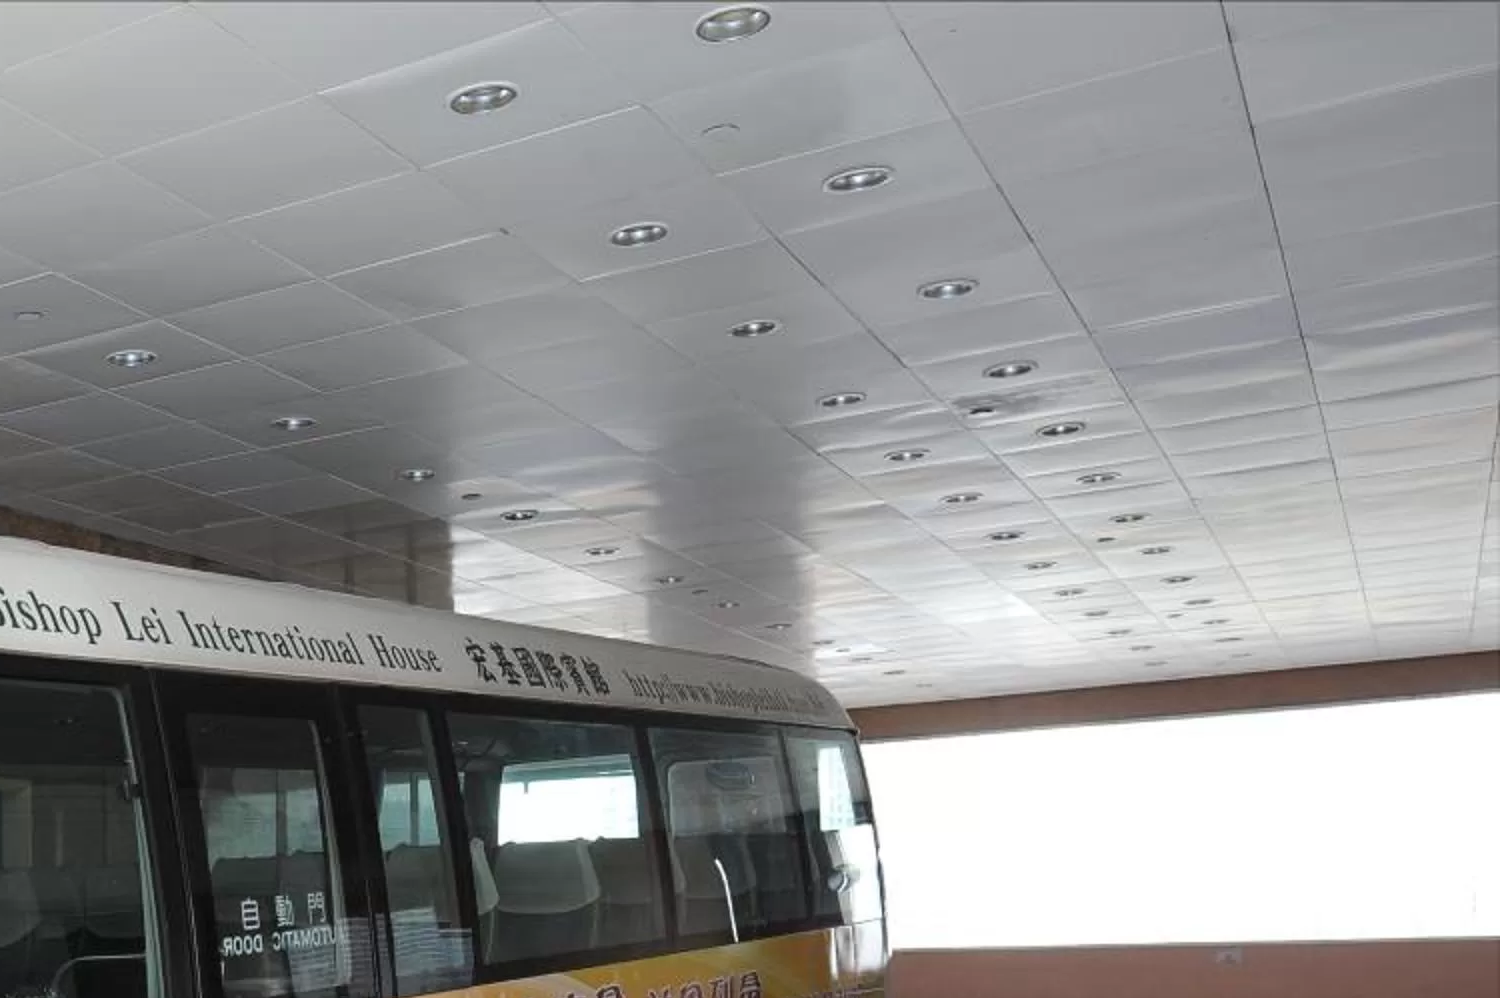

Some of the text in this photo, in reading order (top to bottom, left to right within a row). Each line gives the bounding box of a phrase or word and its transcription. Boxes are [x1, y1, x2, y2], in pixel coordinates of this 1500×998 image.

[110, 600, 174, 646] Lei
[177, 609, 366, 666] International
[368, 633, 443, 673] House
